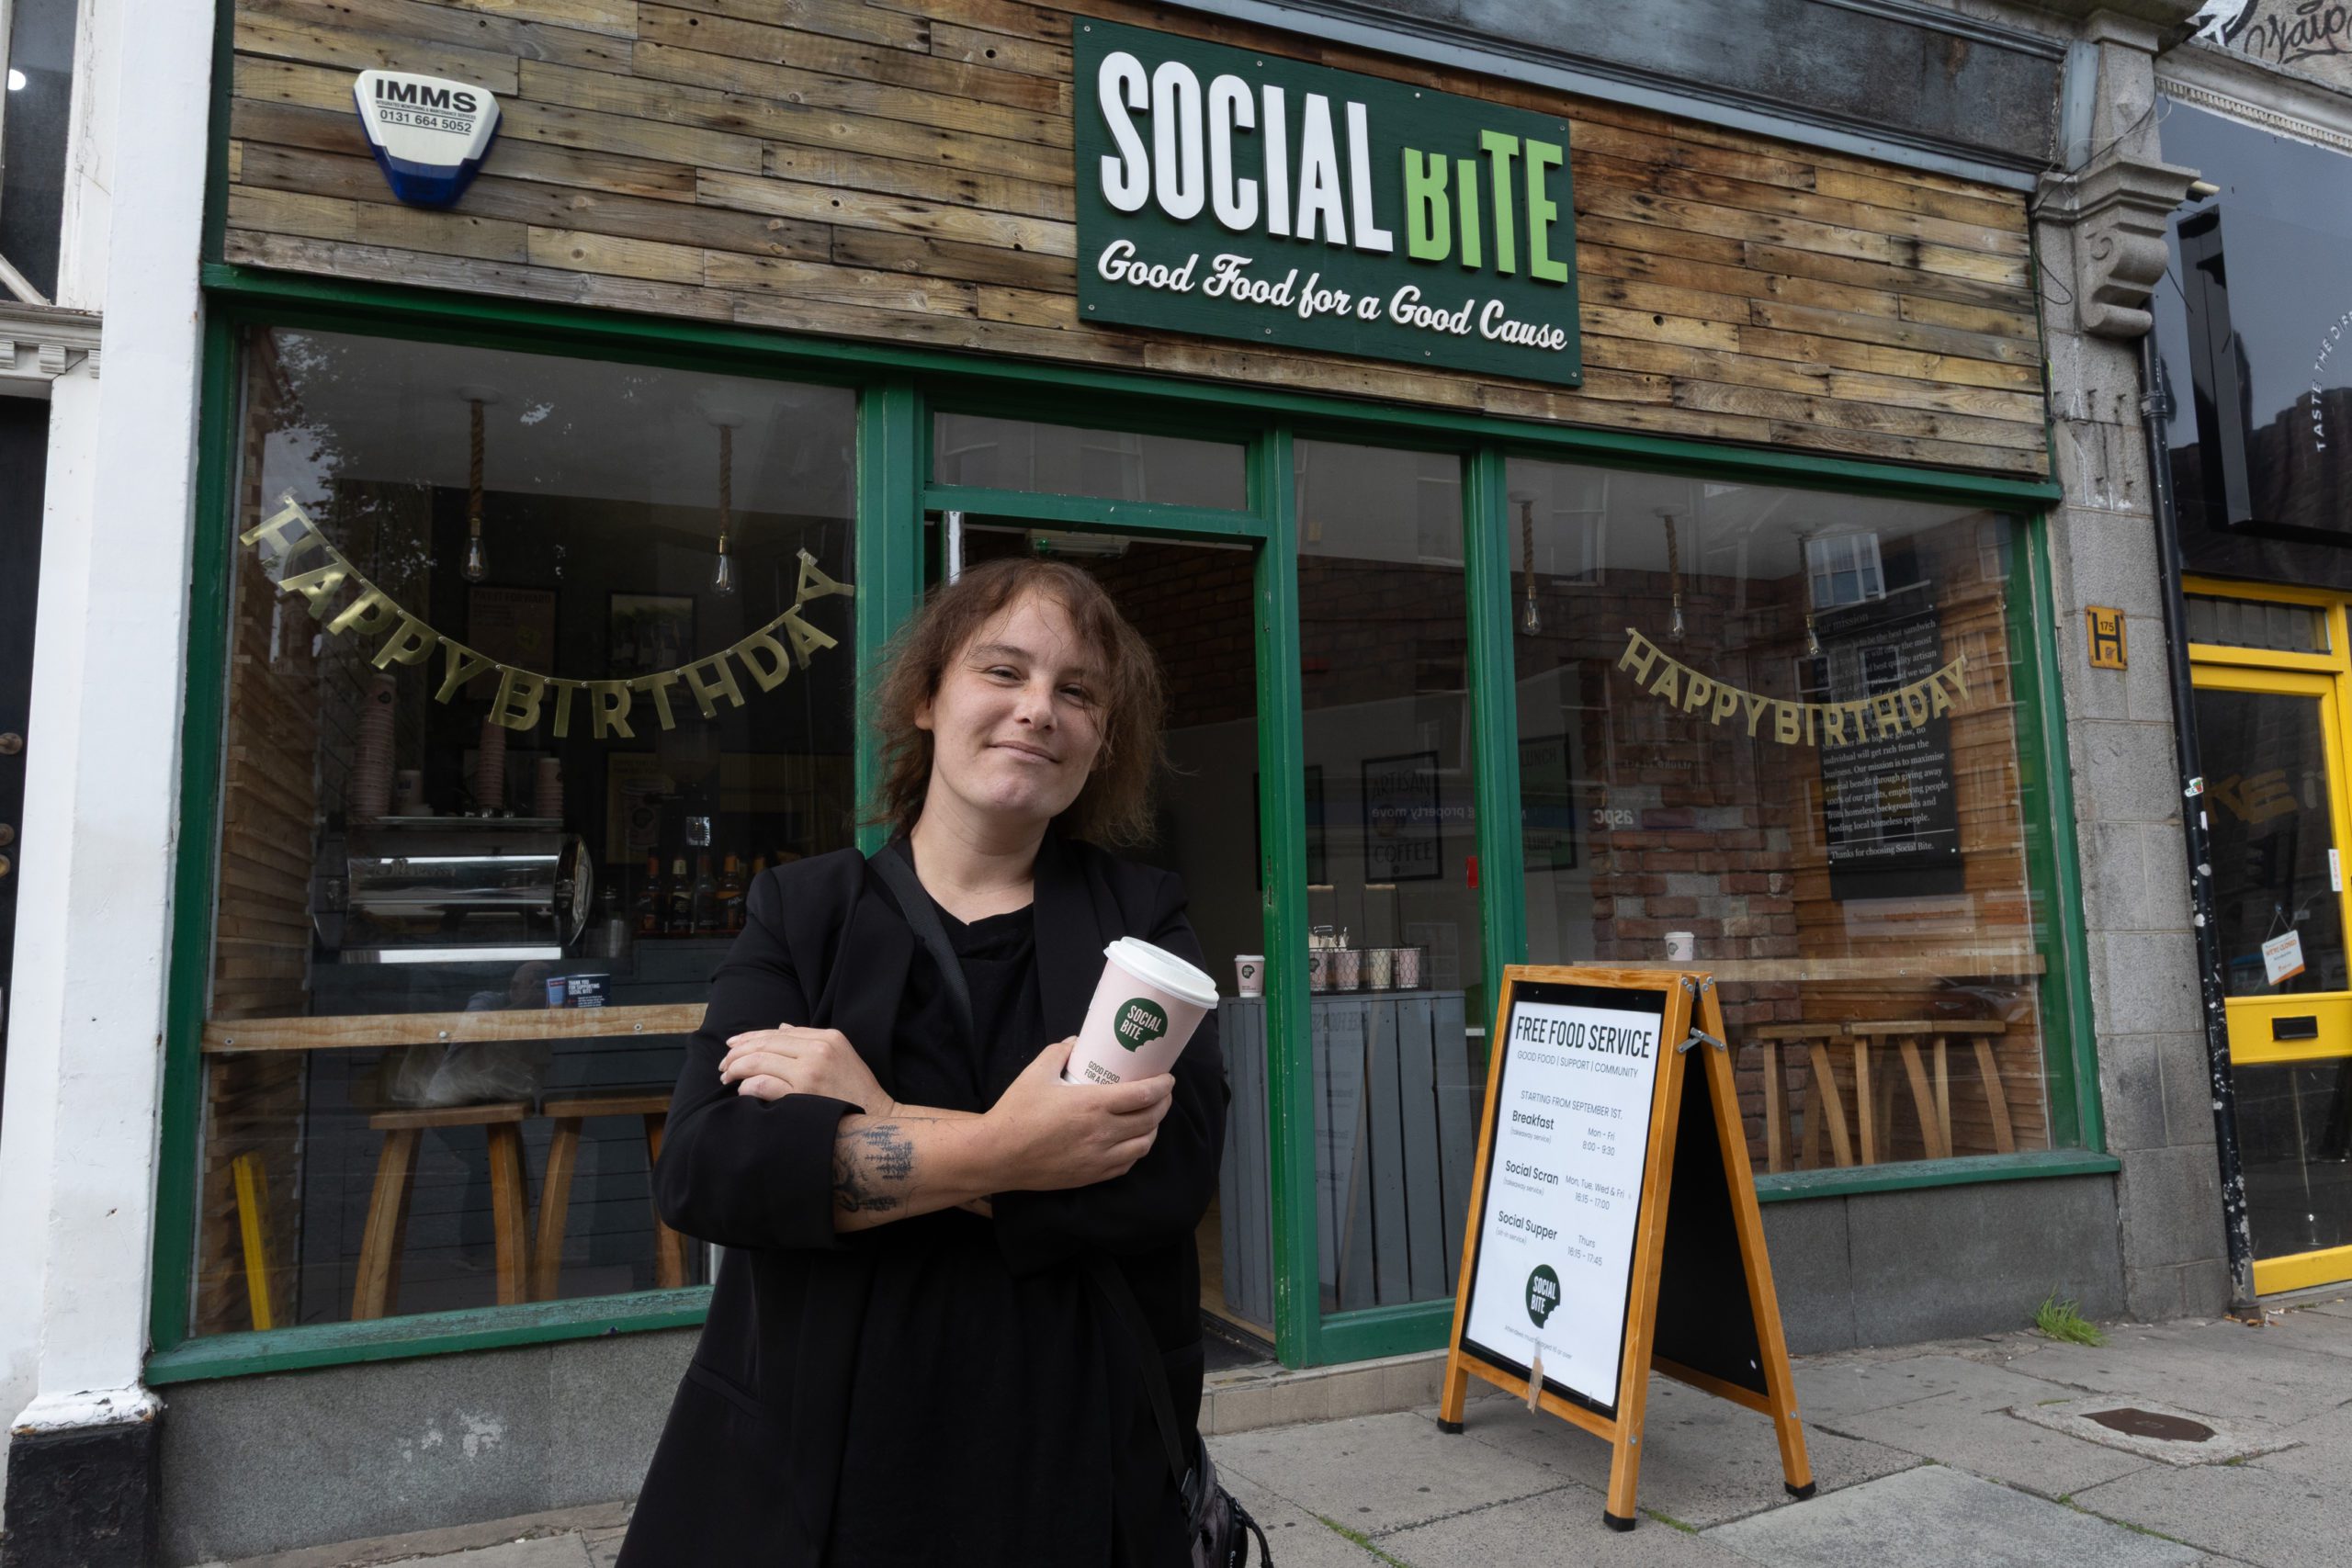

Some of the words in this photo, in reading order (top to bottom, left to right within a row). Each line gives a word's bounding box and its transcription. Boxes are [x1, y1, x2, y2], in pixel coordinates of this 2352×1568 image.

[376, 79, 477, 113] IMMS
[380, 109, 410, 122] 0131
[415, 115, 437, 127] 664
[442, 119, 471, 133] 5052
[1098, 51, 1393, 253] SOCIAL
[1402, 129, 1568, 283] BITE
[1098, 240, 1199, 293] Good
[1204, 253, 1298, 308] Food
[1298, 272, 1351, 319] for
[1356, 296, 1381, 321] a
[1389, 285, 1476, 336] Good
[1479, 299, 1567, 351] Cause
[2314, 338, 2334, 372] THE
[2312, 379, 2327, 452] TASTE
[240, 497, 495, 705] HAPPY
[489, 551, 854, 739] BIRTHDAY
[1833, 613, 1869, 629] mission
[2100, 621, 2115, 632] 175
[1876, 632, 1887, 642] the
[1888, 629, 1902, 640] best
[1904, 619, 1936, 634] sandwich
[2092, 612, 2122, 662] H
[1902, 640, 1913, 650] the
[1914, 636, 1932, 648] most
[1873, 660, 1886, 671] best
[1888, 656, 1911, 670] quality
[1913, 650, 1937, 663] artisan
[1907, 669, 1917, 677] we
[1919, 663, 1932, 674] will
[1618, 629, 1769, 737] HAPPY
[1774, 657, 1970, 746] BIRTHDAY
[1917, 727, 1926, 735] no
[1823, 751, 1856, 765] individual
[1858, 749, 1870, 761] will
[1871, 747, 1882, 759] get
[1883, 743, 1897, 755] rich
[1898, 741, 1916, 752] from
[1917, 739, 1929, 749] the
[1824, 766, 1852, 779] business.
[1853, 764, 1866, 773] Our
[1868, 761, 1894, 773] mission
[1902, 757, 1909, 766] to
[1911, 751, 1945, 765] maximise
[1372, 772, 1430, 801] ARTISAN
[1849, 776, 1871, 789] benefit
[1873, 773, 1900, 786] through
[1901, 769, 1923, 783] giving
[1924, 767, 1942, 779] away
[1844, 793, 1852, 804] of
[1852, 794, 1863, 803] our
[1888, 784, 1924, 799] employing
[1925, 780, 1949, 794] people
[1827, 809, 1844, 819] from
[1845, 806, 1875, 818] homeless
[1876, 798, 1921, 814] backgrounds
[1922, 796, 1937, 807] and
[1828, 821, 1852, 833] feeding
[1854, 819, 1870, 830] local
[1871, 816, 1903, 828] homeless
[1904, 813, 1930, 826] people.
[1374, 841, 1434, 865] COFFEE
[1831, 848, 1854, 860] Thanks
[1855, 847, 1864, 857] for
[1865, 845, 1894, 858] choosing
[1895, 841, 1917, 852] Social
[1917, 840, 1934, 851] Bite.
[1120, 1019, 1144, 1041] BITE
[1126, 1005, 1162, 1032] SOCIAL
[1516, 1016, 1548, 1043] FREE
[1548, 1020, 1585, 1049] FOOD
[1589, 1024, 1652, 1058] SERVICE
[1084, 1068, 1095, 1082] FOR
[1088, 1061, 1104, 1075] GOOD
[1104, 1069, 1120, 1083] FOOD
[1517, 1050, 1537, 1062] GOOD
[1538, 1054, 1555, 1065] FOOD
[1560, 1056, 1589, 1070] SUPPORT
[1595, 1063, 1638, 1078] COMMUNITY
[1521, 1090, 1551, 1105] STARTING
[1552, 1096, 1571, 1109] FROM
[1572, 1100, 1610, 1117] SEPTEMBER
[1512, 1110, 1555, 1131] Breakfast
[1582, 1140, 1595, 1152] 8:00
[1588, 1127, 1601, 1138] Mon
[1607, 1132, 1615, 1141] Fri
[1506, 1160, 1532, 1178] Social
[1533, 1168, 1559, 1185] Scran
[1566, 1175, 1579, 1187] Mon,
[1581, 1179, 1593, 1190] Tue,
[1595, 1182, 1609, 1194] Wed
[1616, 1190, 1624, 1199] Fri
[1498, 1211, 1523, 1229] Social
[1525, 1219, 1557, 1241] Supper
[1578, 1235, 1596, 1248] Thurs
[1532, 1275, 1556, 1301] SOCIAL
[1530, 1293, 1545, 1314] BITE
